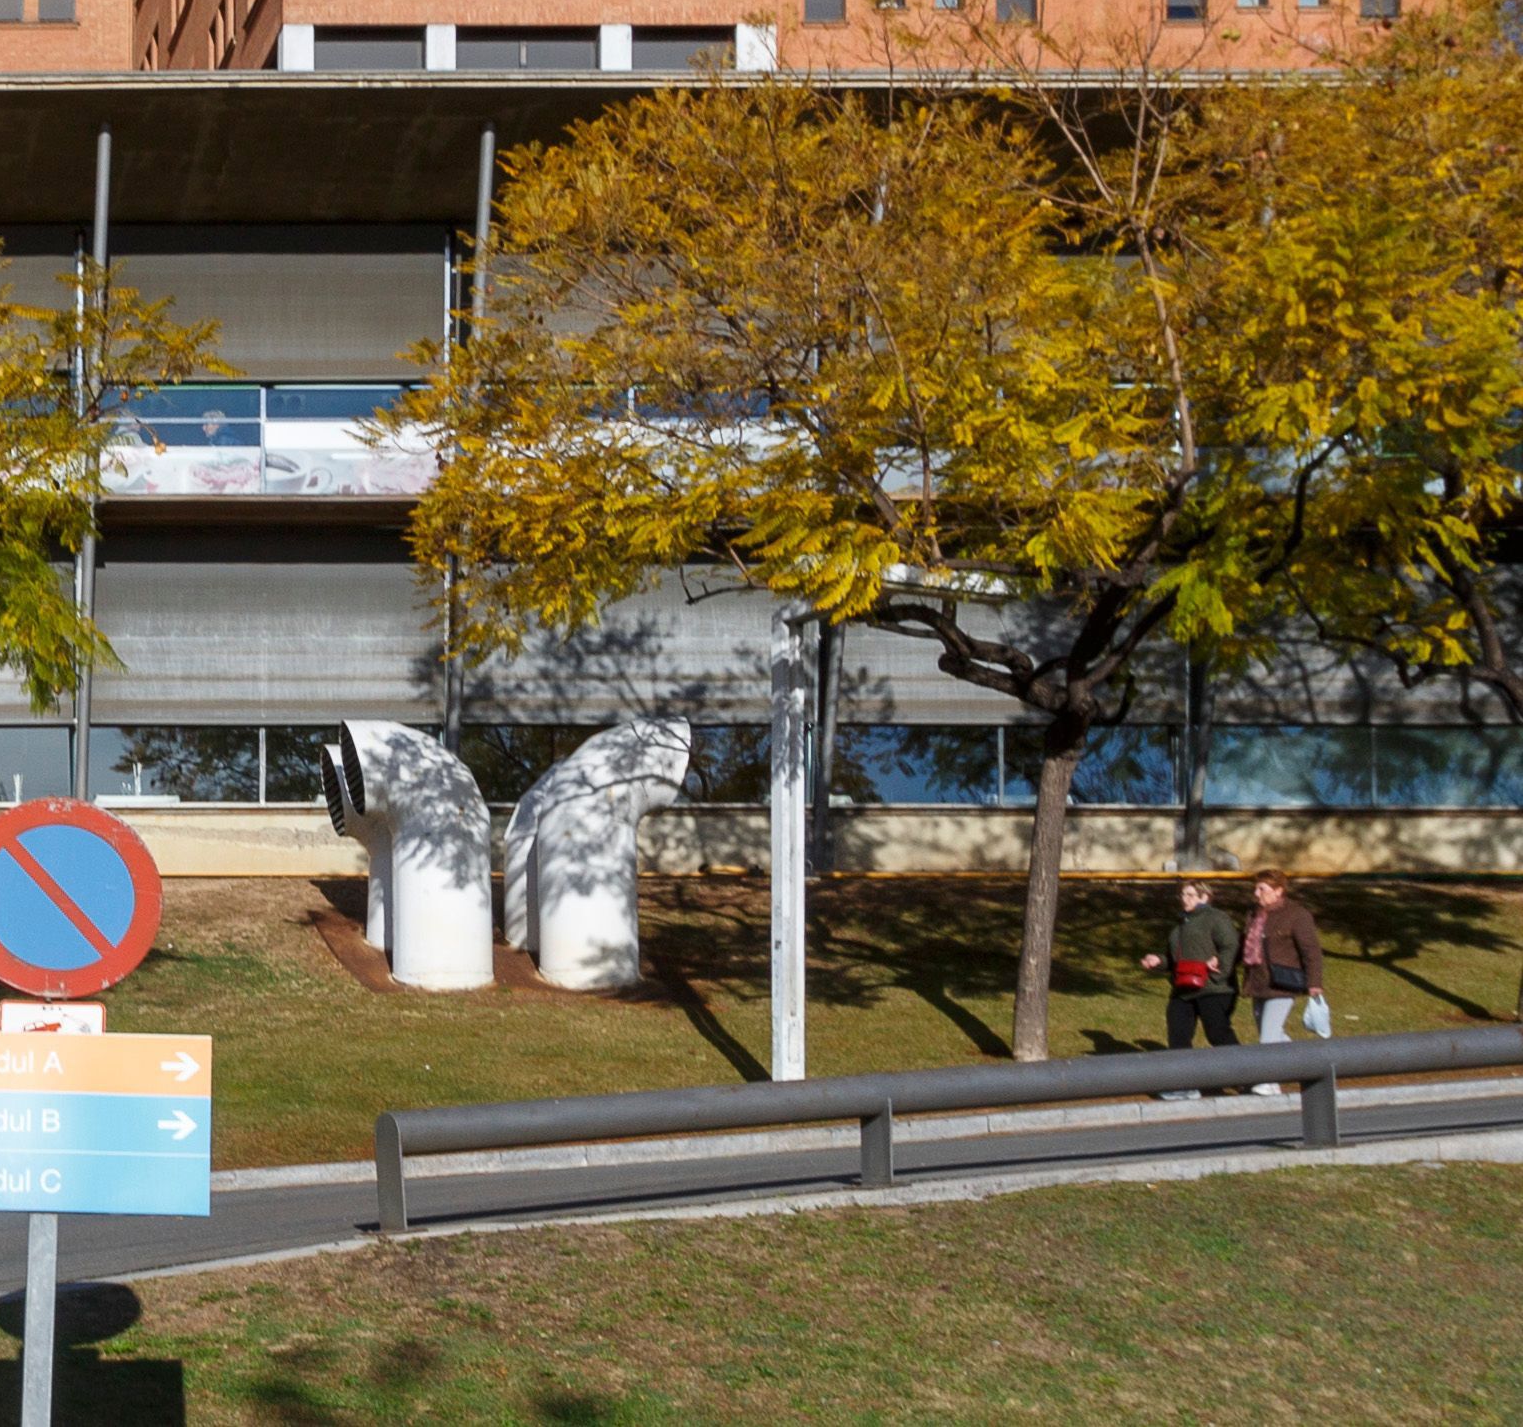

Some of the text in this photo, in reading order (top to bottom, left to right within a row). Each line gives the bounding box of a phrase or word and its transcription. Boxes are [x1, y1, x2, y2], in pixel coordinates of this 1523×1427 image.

[42, 1051, 64, 1074] A
[42, 1108, 61, 1133] B
[39, 1169, 62, 1194] C
